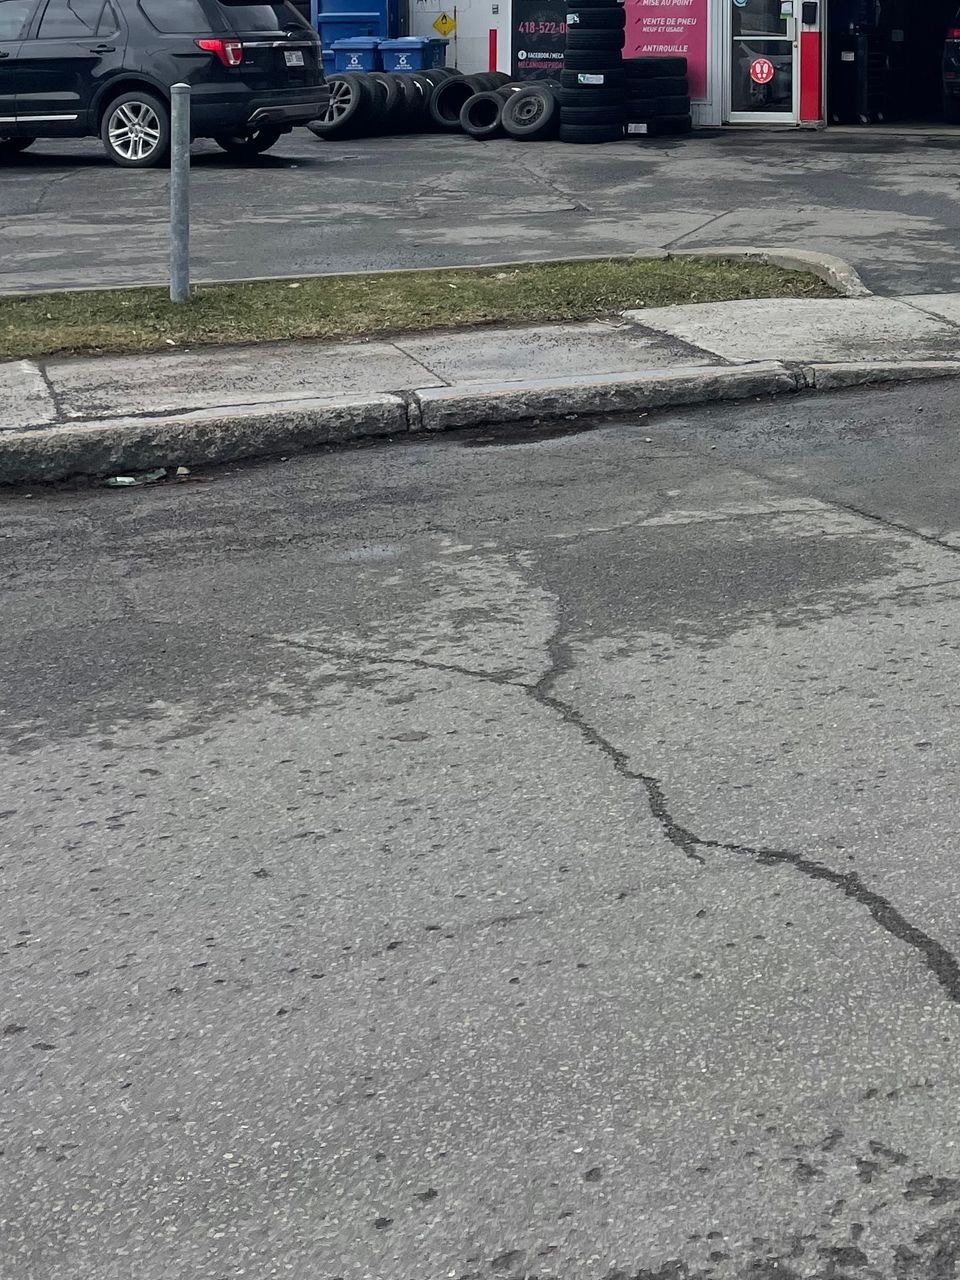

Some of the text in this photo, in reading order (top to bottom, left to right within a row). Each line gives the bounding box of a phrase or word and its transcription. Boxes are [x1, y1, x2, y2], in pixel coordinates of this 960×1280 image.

[643, 17, 697, 25] VENTE DE PNEU
[642, 44, 689, 53] ANTIROUILLE
